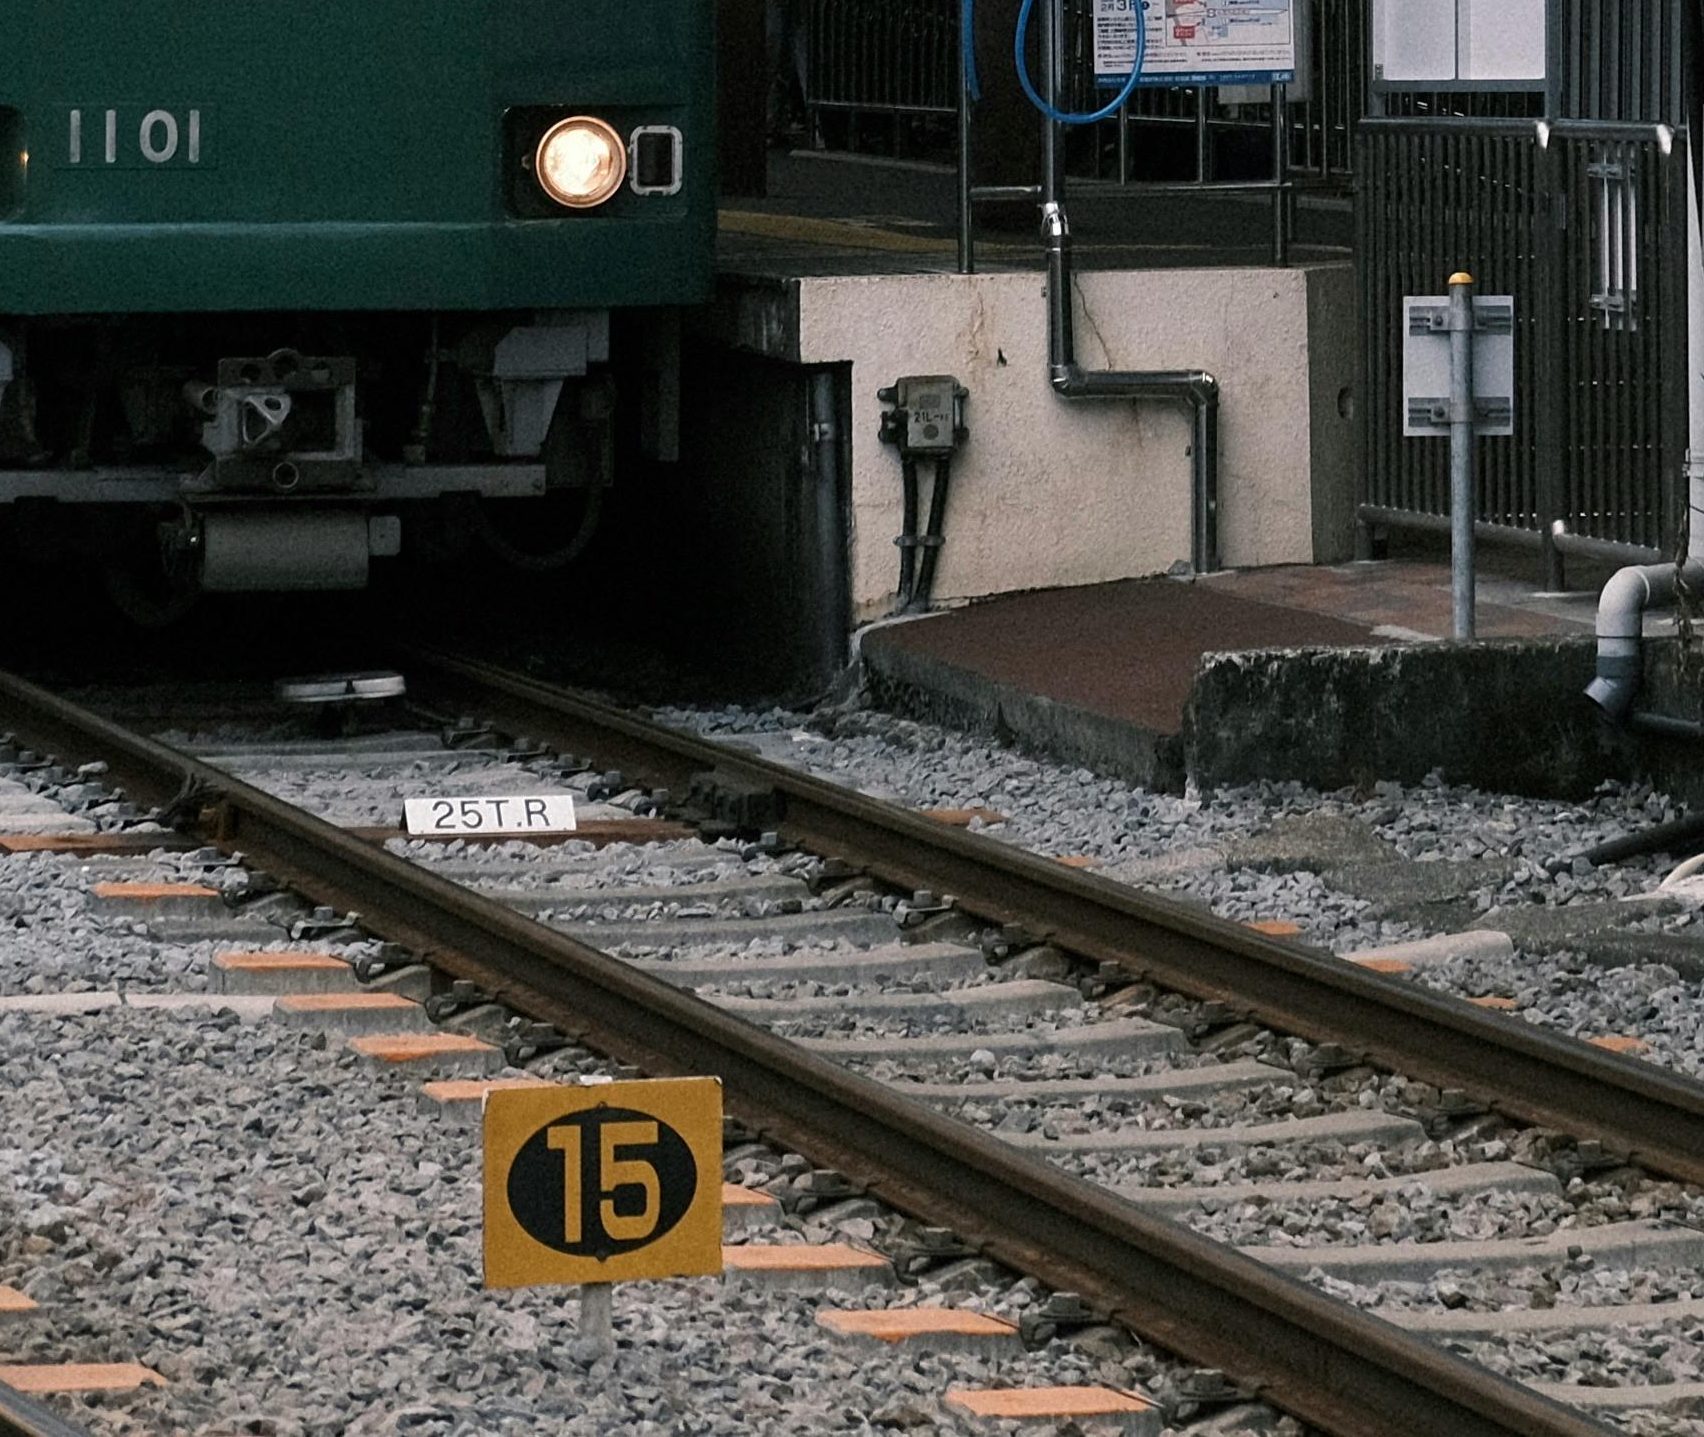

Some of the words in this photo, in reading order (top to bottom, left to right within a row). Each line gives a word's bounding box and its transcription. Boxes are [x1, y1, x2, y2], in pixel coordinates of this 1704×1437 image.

[67, 109, 202, 164] 1101
[431, 799, 551, 829] 25T.R
[547, 1120, 662, 1244] 15
